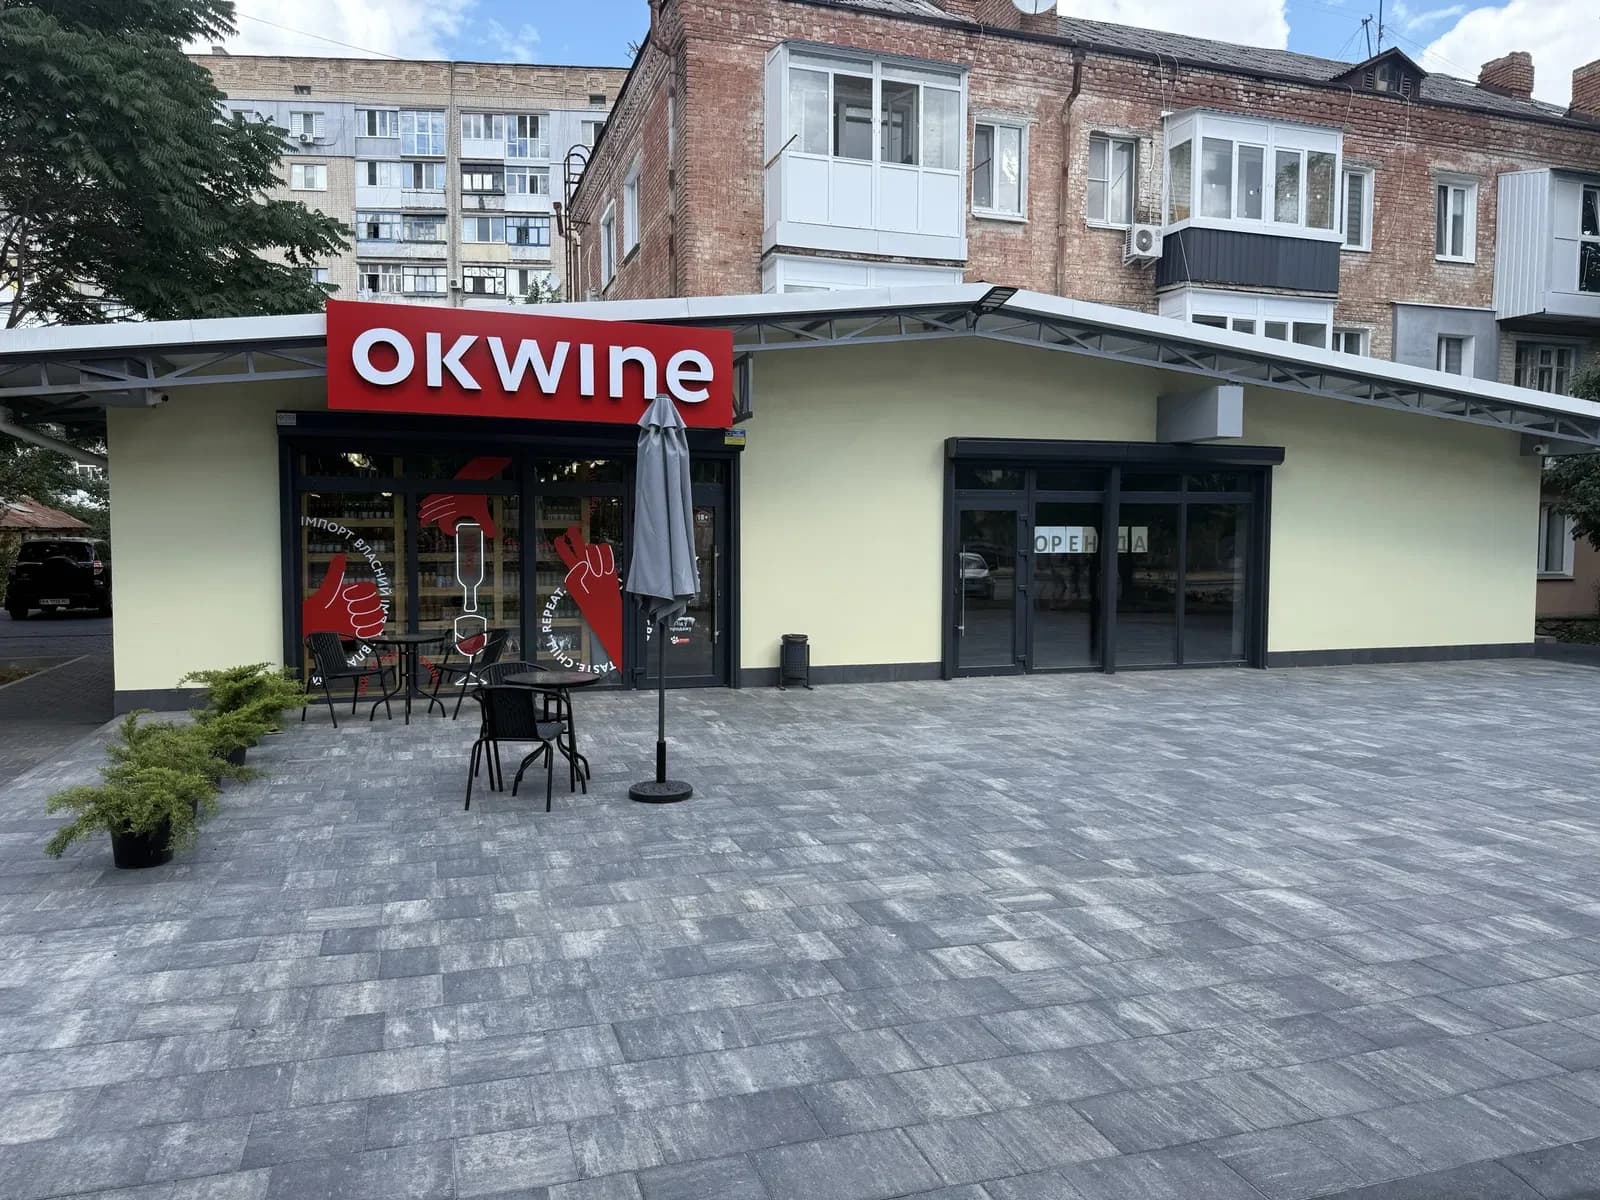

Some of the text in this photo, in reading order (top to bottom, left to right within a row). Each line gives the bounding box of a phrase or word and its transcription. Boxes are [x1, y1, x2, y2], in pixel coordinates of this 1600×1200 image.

[301, 515, 355, 540] ІМПОРТ
[354, 538, 393, 597] ВЛАСНИЙ
[541, 587, 567, 633] REPEAT.
